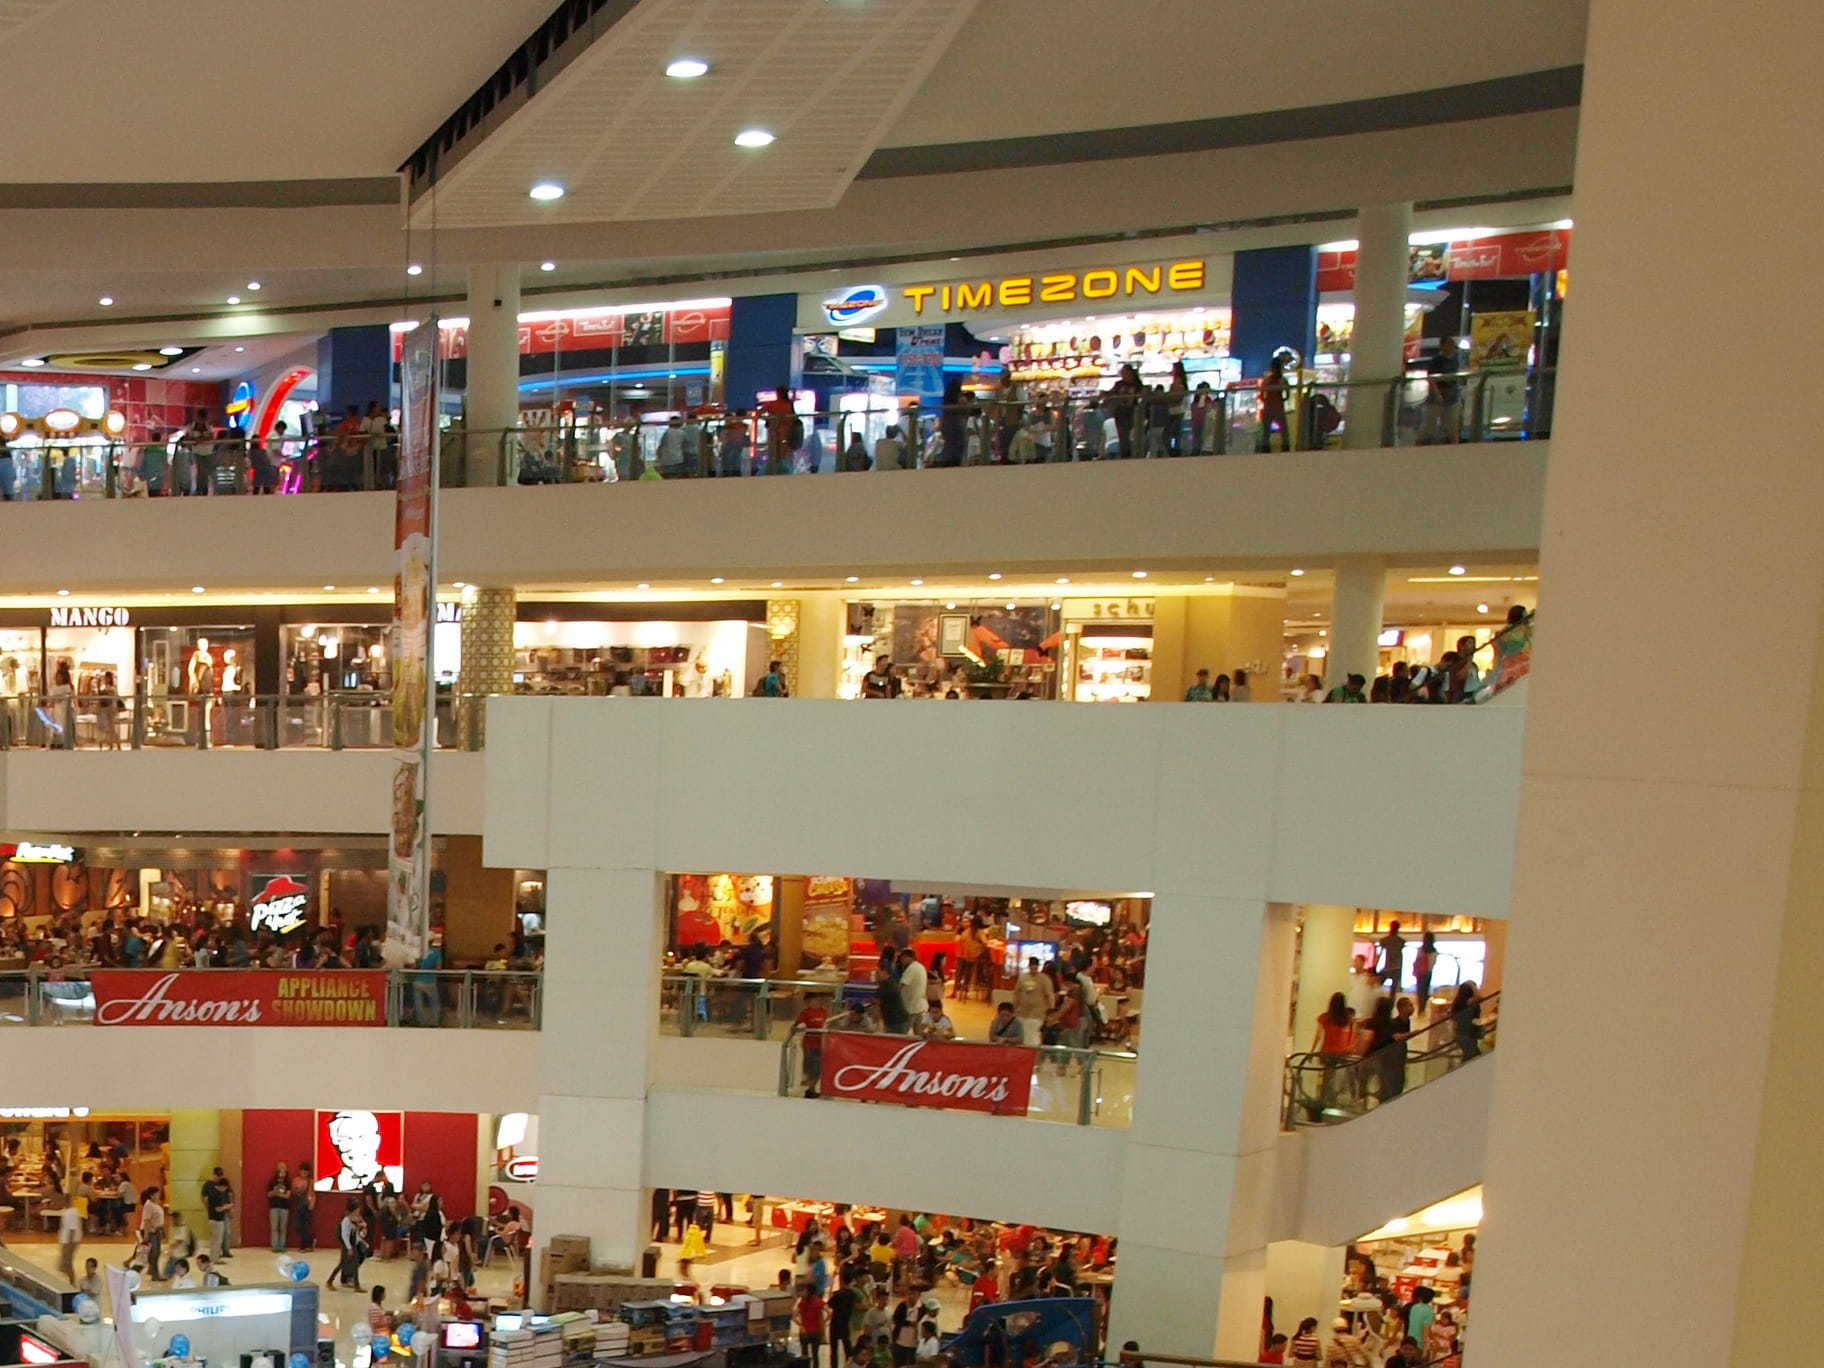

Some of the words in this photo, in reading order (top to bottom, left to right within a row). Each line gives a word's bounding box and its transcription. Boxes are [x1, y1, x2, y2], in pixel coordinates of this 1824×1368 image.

[903, 259, 1207, 314] TIMEZONE
[50, 606, 130, 627] MANGO
[97, 973, 262, 1024] Anson's
[277, 975, 372, 999] APPLIANCE
[272, 998, 376, 1023] SHOWDOWN
[834, 1042, 1010, 1105] Anson's
